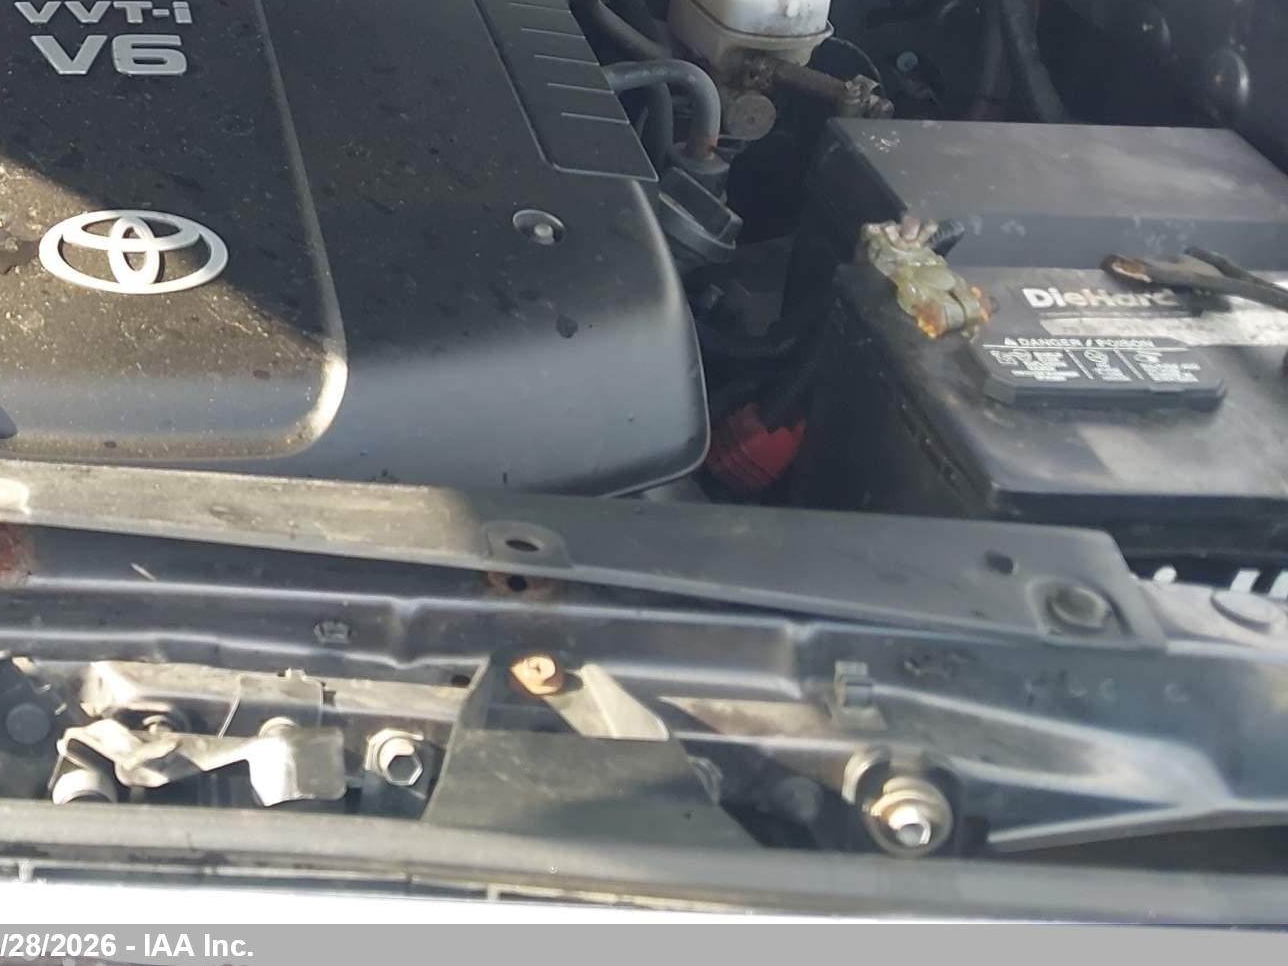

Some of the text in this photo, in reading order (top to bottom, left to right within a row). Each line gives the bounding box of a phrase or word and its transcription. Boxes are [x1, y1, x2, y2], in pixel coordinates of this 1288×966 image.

[14, 0, 193, 24] VVT-i
[29, 34, 188, 76] V6
[1016, 337, 1083, 348] DANGER
